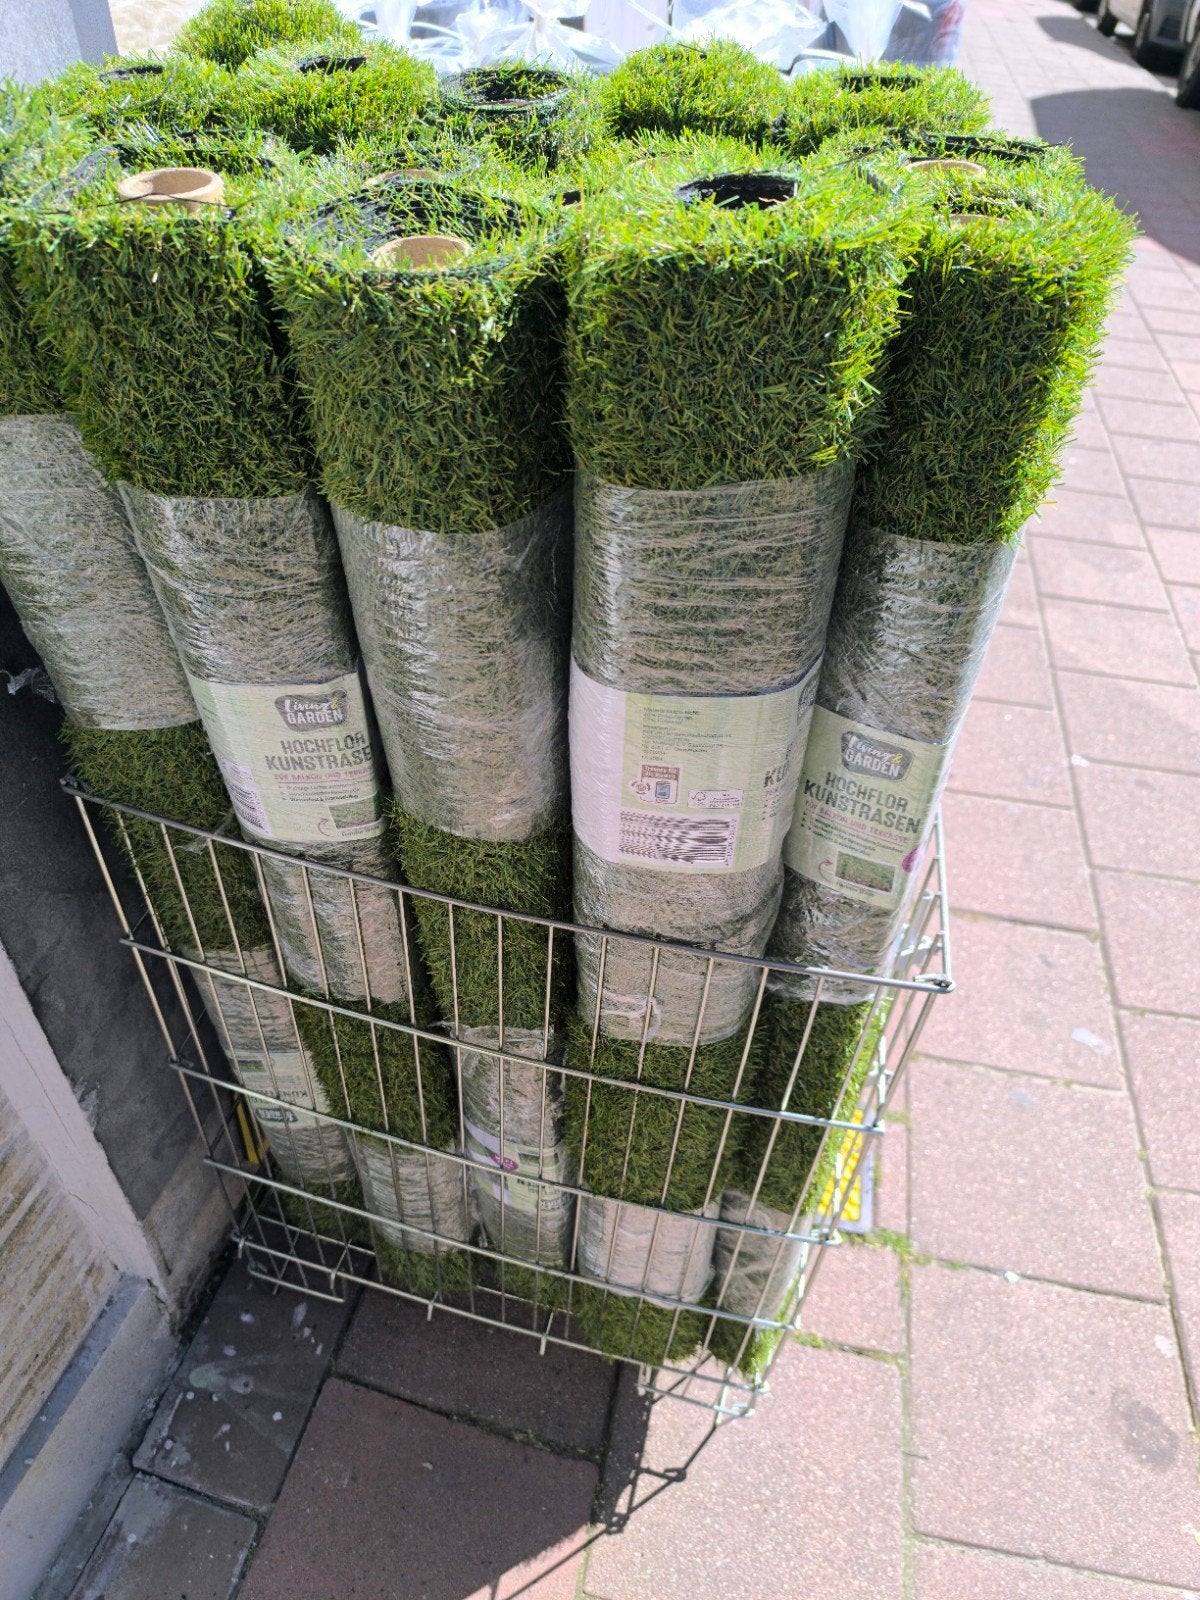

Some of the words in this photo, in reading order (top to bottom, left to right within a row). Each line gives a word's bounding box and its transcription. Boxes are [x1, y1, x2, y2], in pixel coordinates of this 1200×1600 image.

[286, 708, 344, 725] GARDEN
[280, 731, 366, 755] HOCHFLOR
[264, 744, 372, 771] KUNSTRASE
[845, 748, 901, 777] GARDEN
[825, 771, 909, 813] HOCHFLOR
[804, 779, 921, 834] KUNSTRASEN
